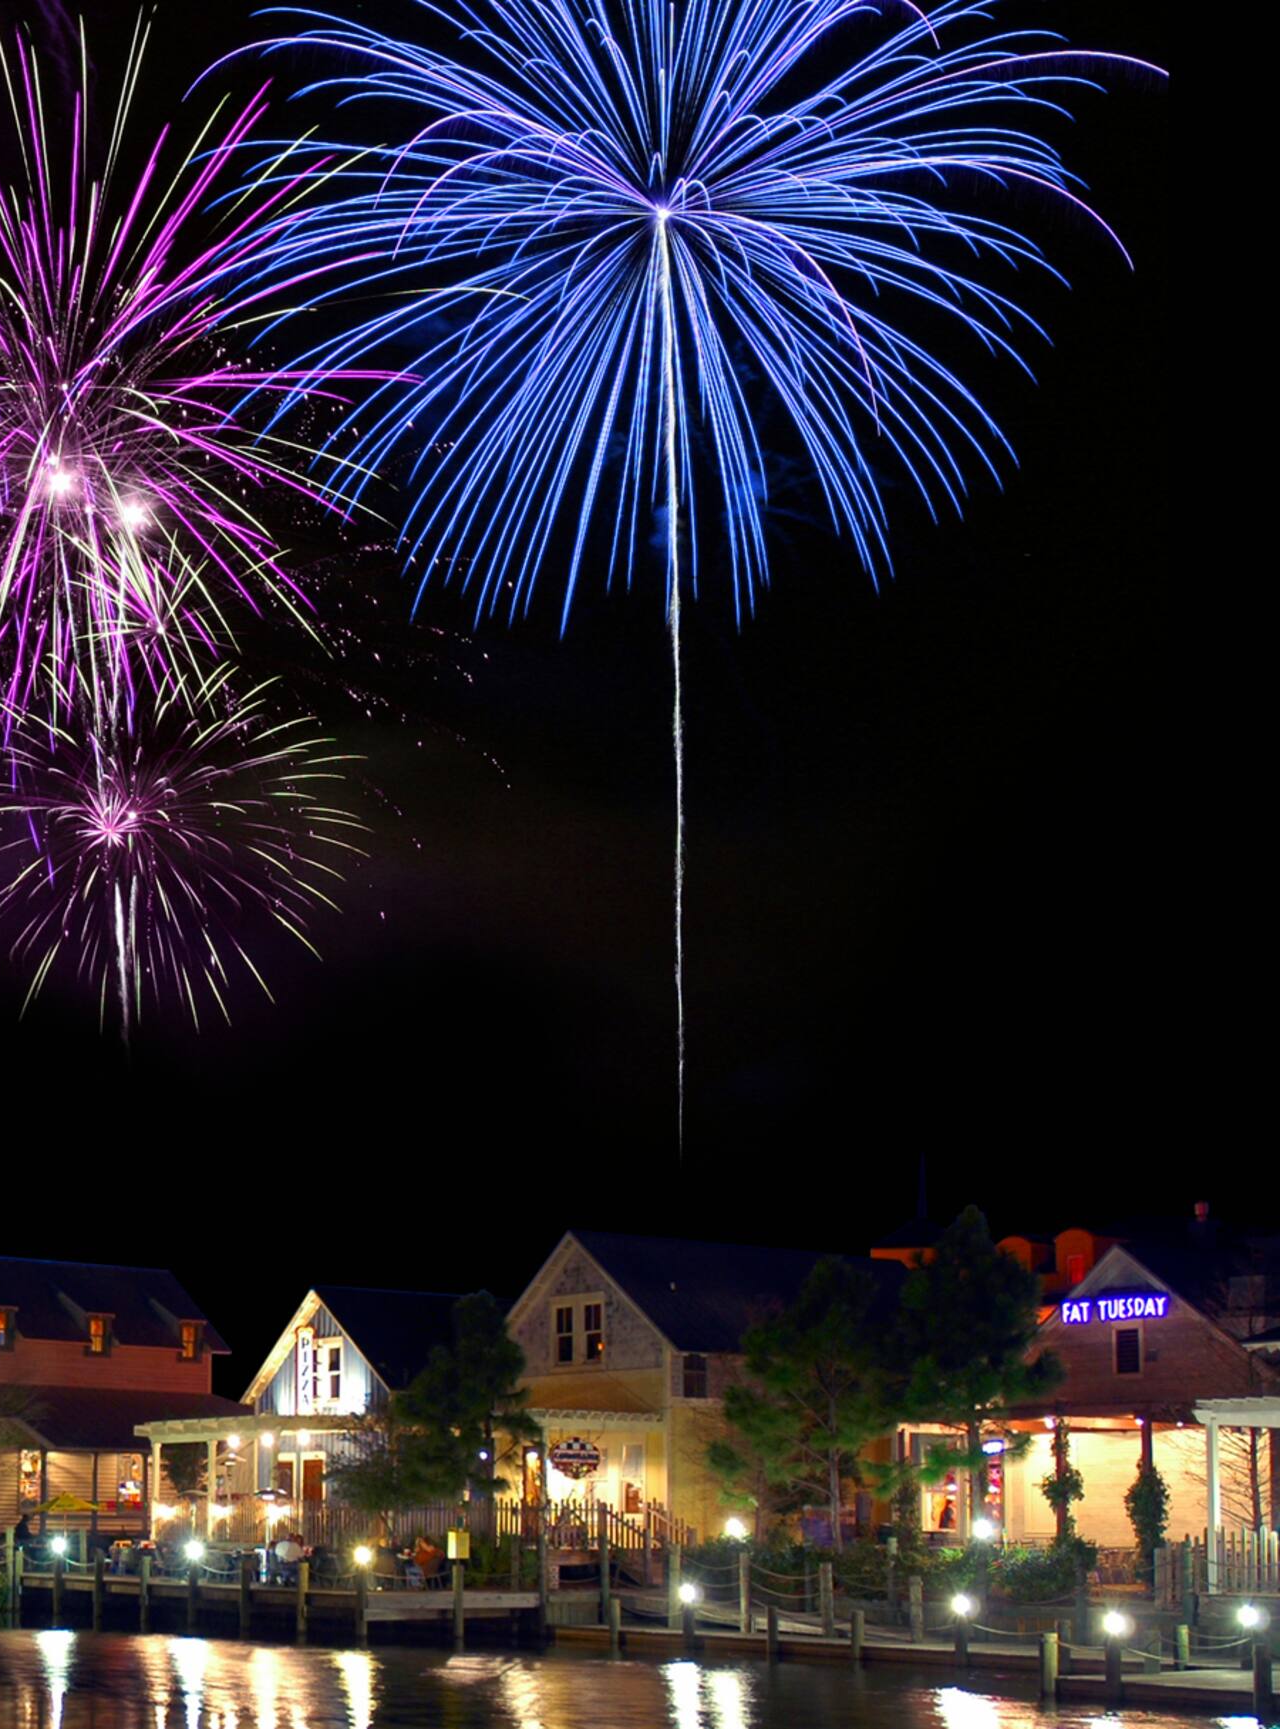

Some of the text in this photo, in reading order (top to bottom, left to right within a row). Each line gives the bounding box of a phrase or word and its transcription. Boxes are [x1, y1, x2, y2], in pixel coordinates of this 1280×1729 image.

[1061, 1297, 1167, 1324] FAT TUESDAY
[300, 1336, 311, 1406] PIZZA
